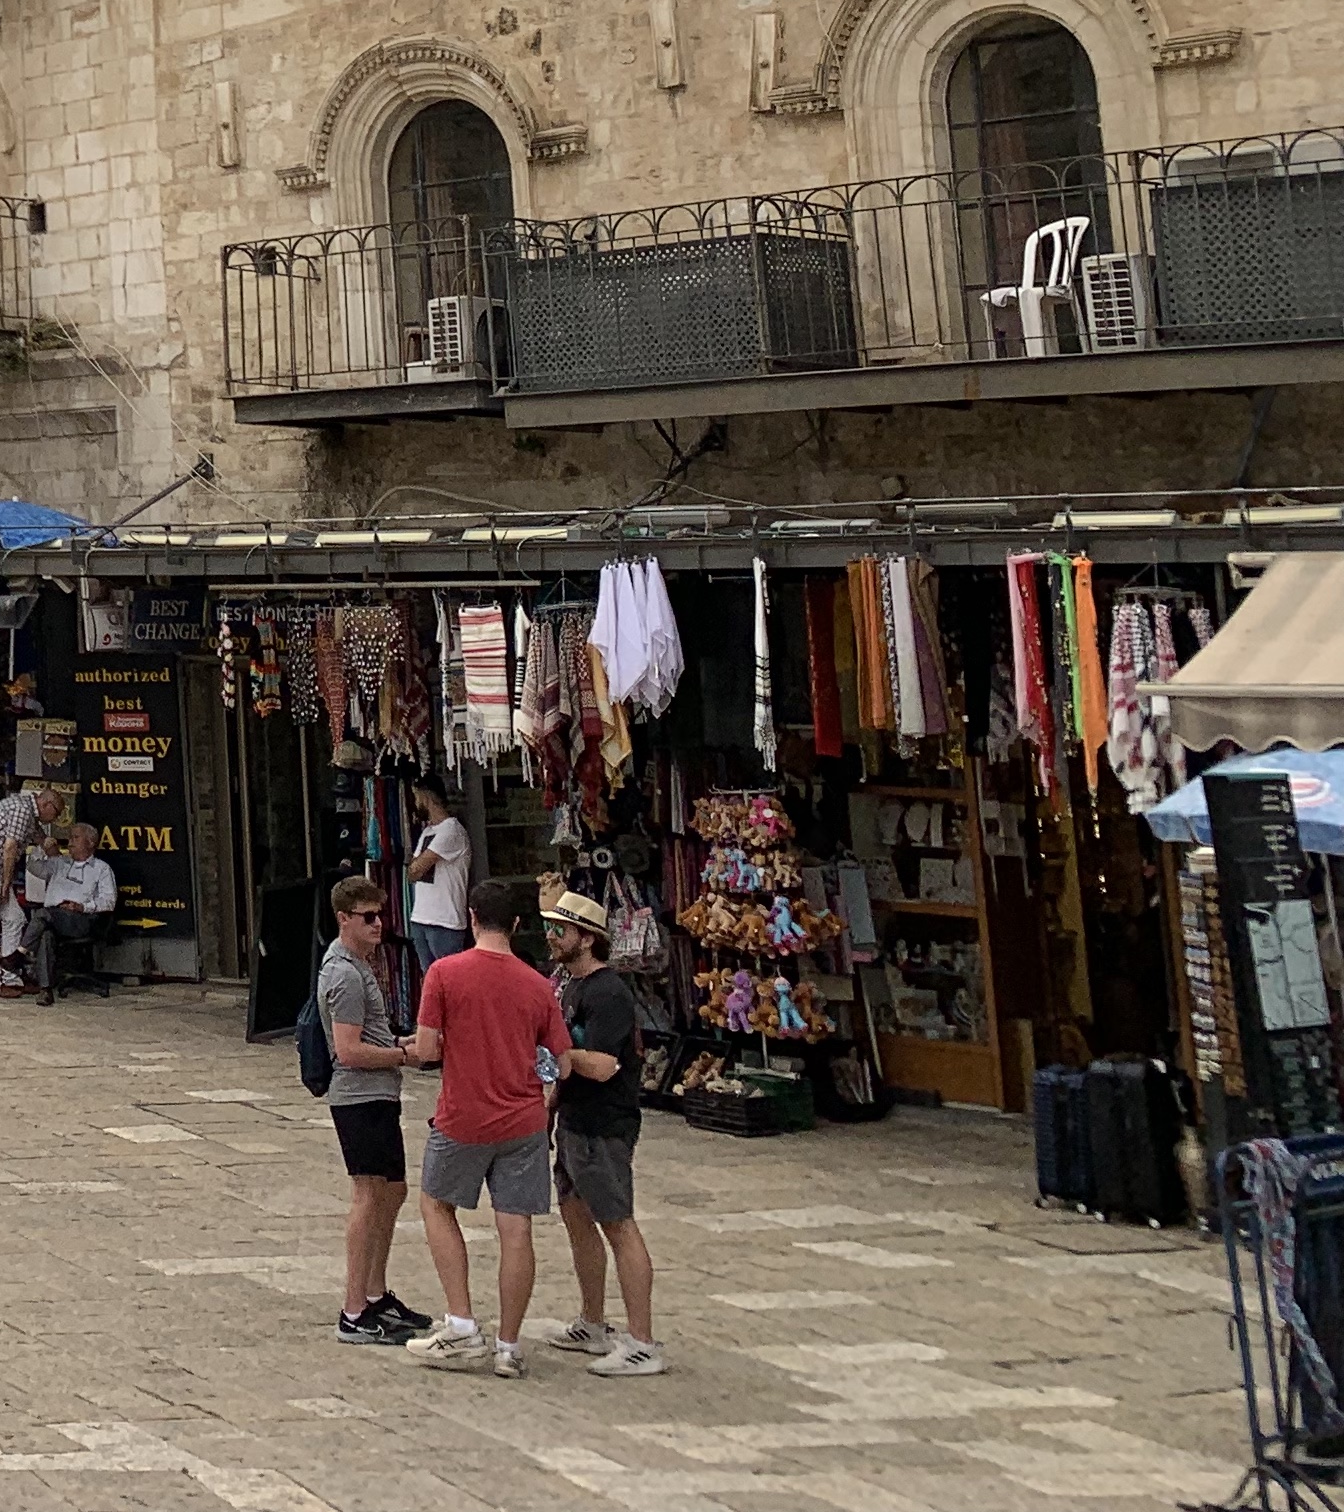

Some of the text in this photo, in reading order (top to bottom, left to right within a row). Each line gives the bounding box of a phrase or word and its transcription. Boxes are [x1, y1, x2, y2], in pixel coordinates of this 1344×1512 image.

[150, 599, 189, 617] BEST
[135, 622, 200, 640] CHANGE
[75, 667, 170, 683] authorized
[104, 695, 143, 710] best
[83, 736, 172, 758] money
[90, 777, 168, 798] changer
[98, 826, 175, 852] ATM
[125, 899, 185, 909] credit cards
